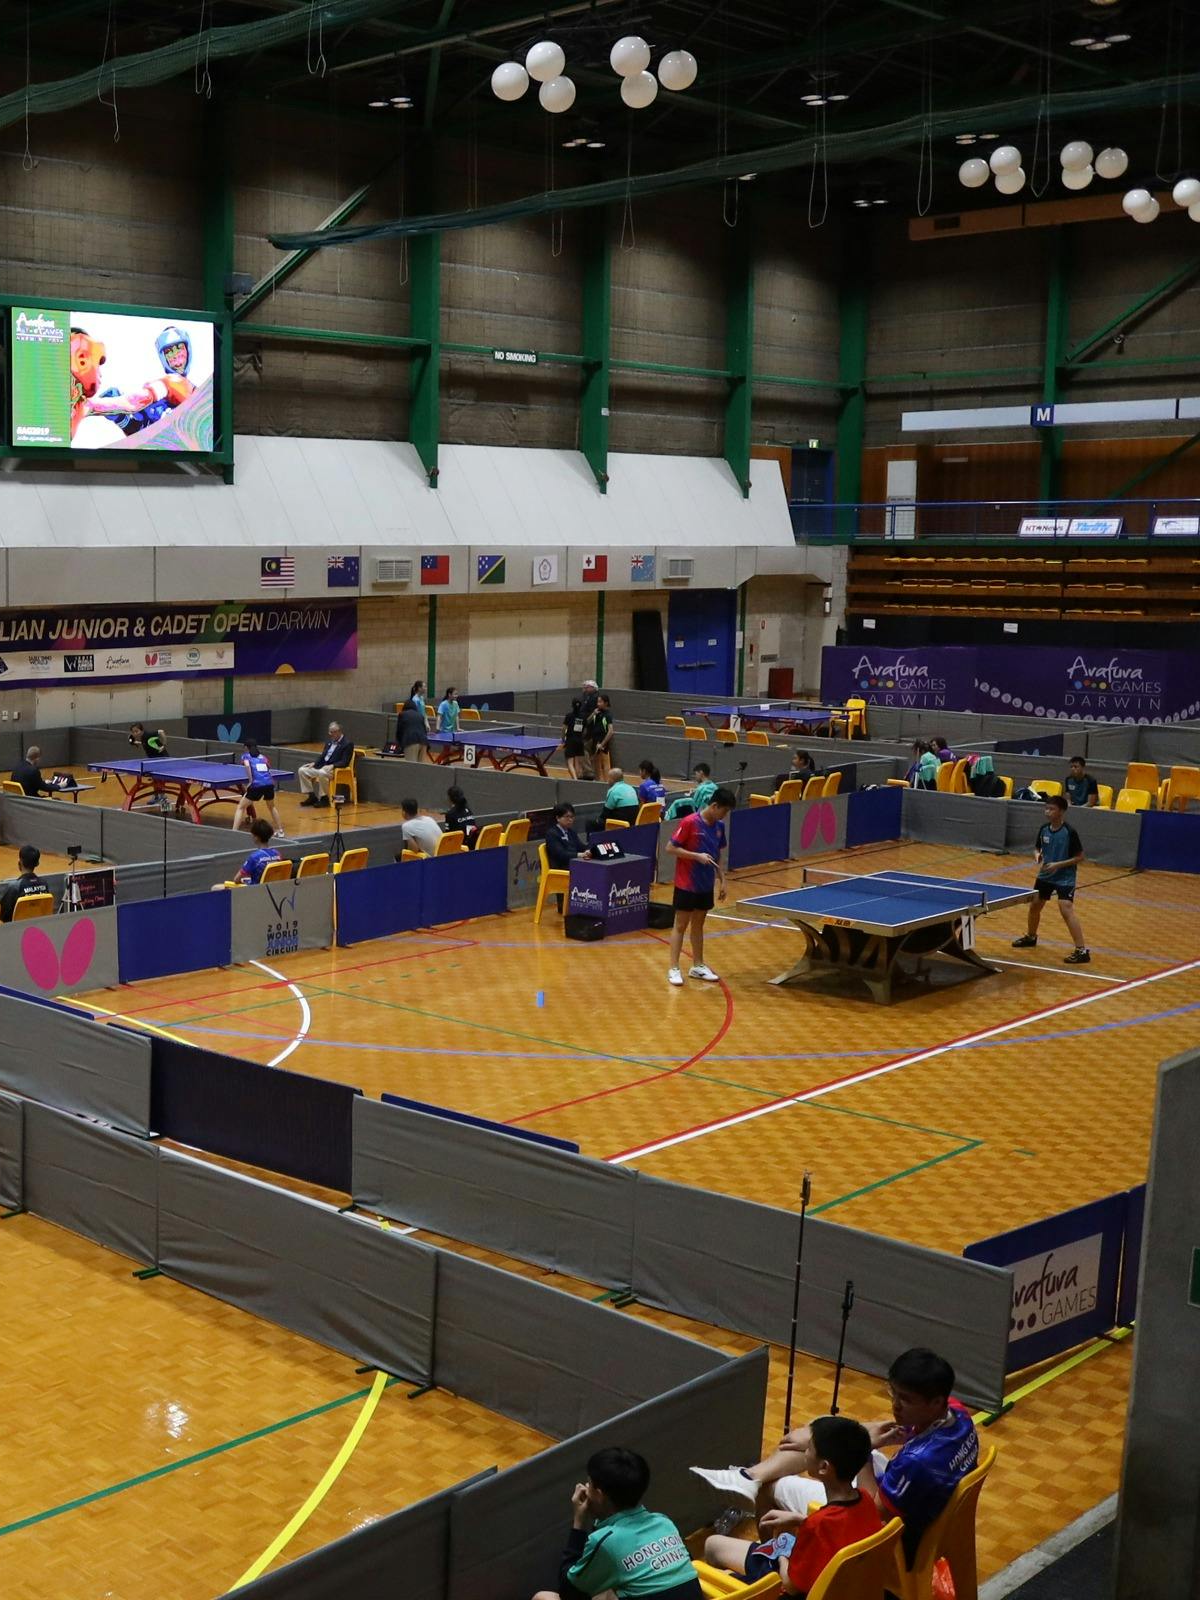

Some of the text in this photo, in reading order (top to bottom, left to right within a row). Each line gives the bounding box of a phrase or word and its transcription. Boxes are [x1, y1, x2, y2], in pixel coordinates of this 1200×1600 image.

[494, 351, 536, 363] NO SMOKING
[1036, 407, 1051, 422] M
[49, 617, 128, 641] JUNIOR
[133, 617, 146, 638] &
[150, 613, 211, 636] CADET
[213, 612, 264, 633] OPEN
[266, 610, 332, 631] DARWIN
[852, 655, 929, 681] Arafura
[1066, 655, 1144, 683] Arafura
[898, 678, 947, 691] GAMES
[1110, 680, 1162, 693] GAMES
[1064, 694, 1162, 711] DARWIN
[732, 716, 739, 729] 7
[465, 747, 474, 762] 6
[267, 920, 298, 932] 2019
[965, 920, 972, 946] 1
[267, 929, 298, 941] WORLD
[265, 944, 298, 956] CIRCUIT
[1013, 1252, 1079, 1310] rafura
[1041, 1285, 1097, 1325] GAMES
[622, 1533, 682, 1572] HONG KON
[650, 1548, 685, 1572] CHINA
